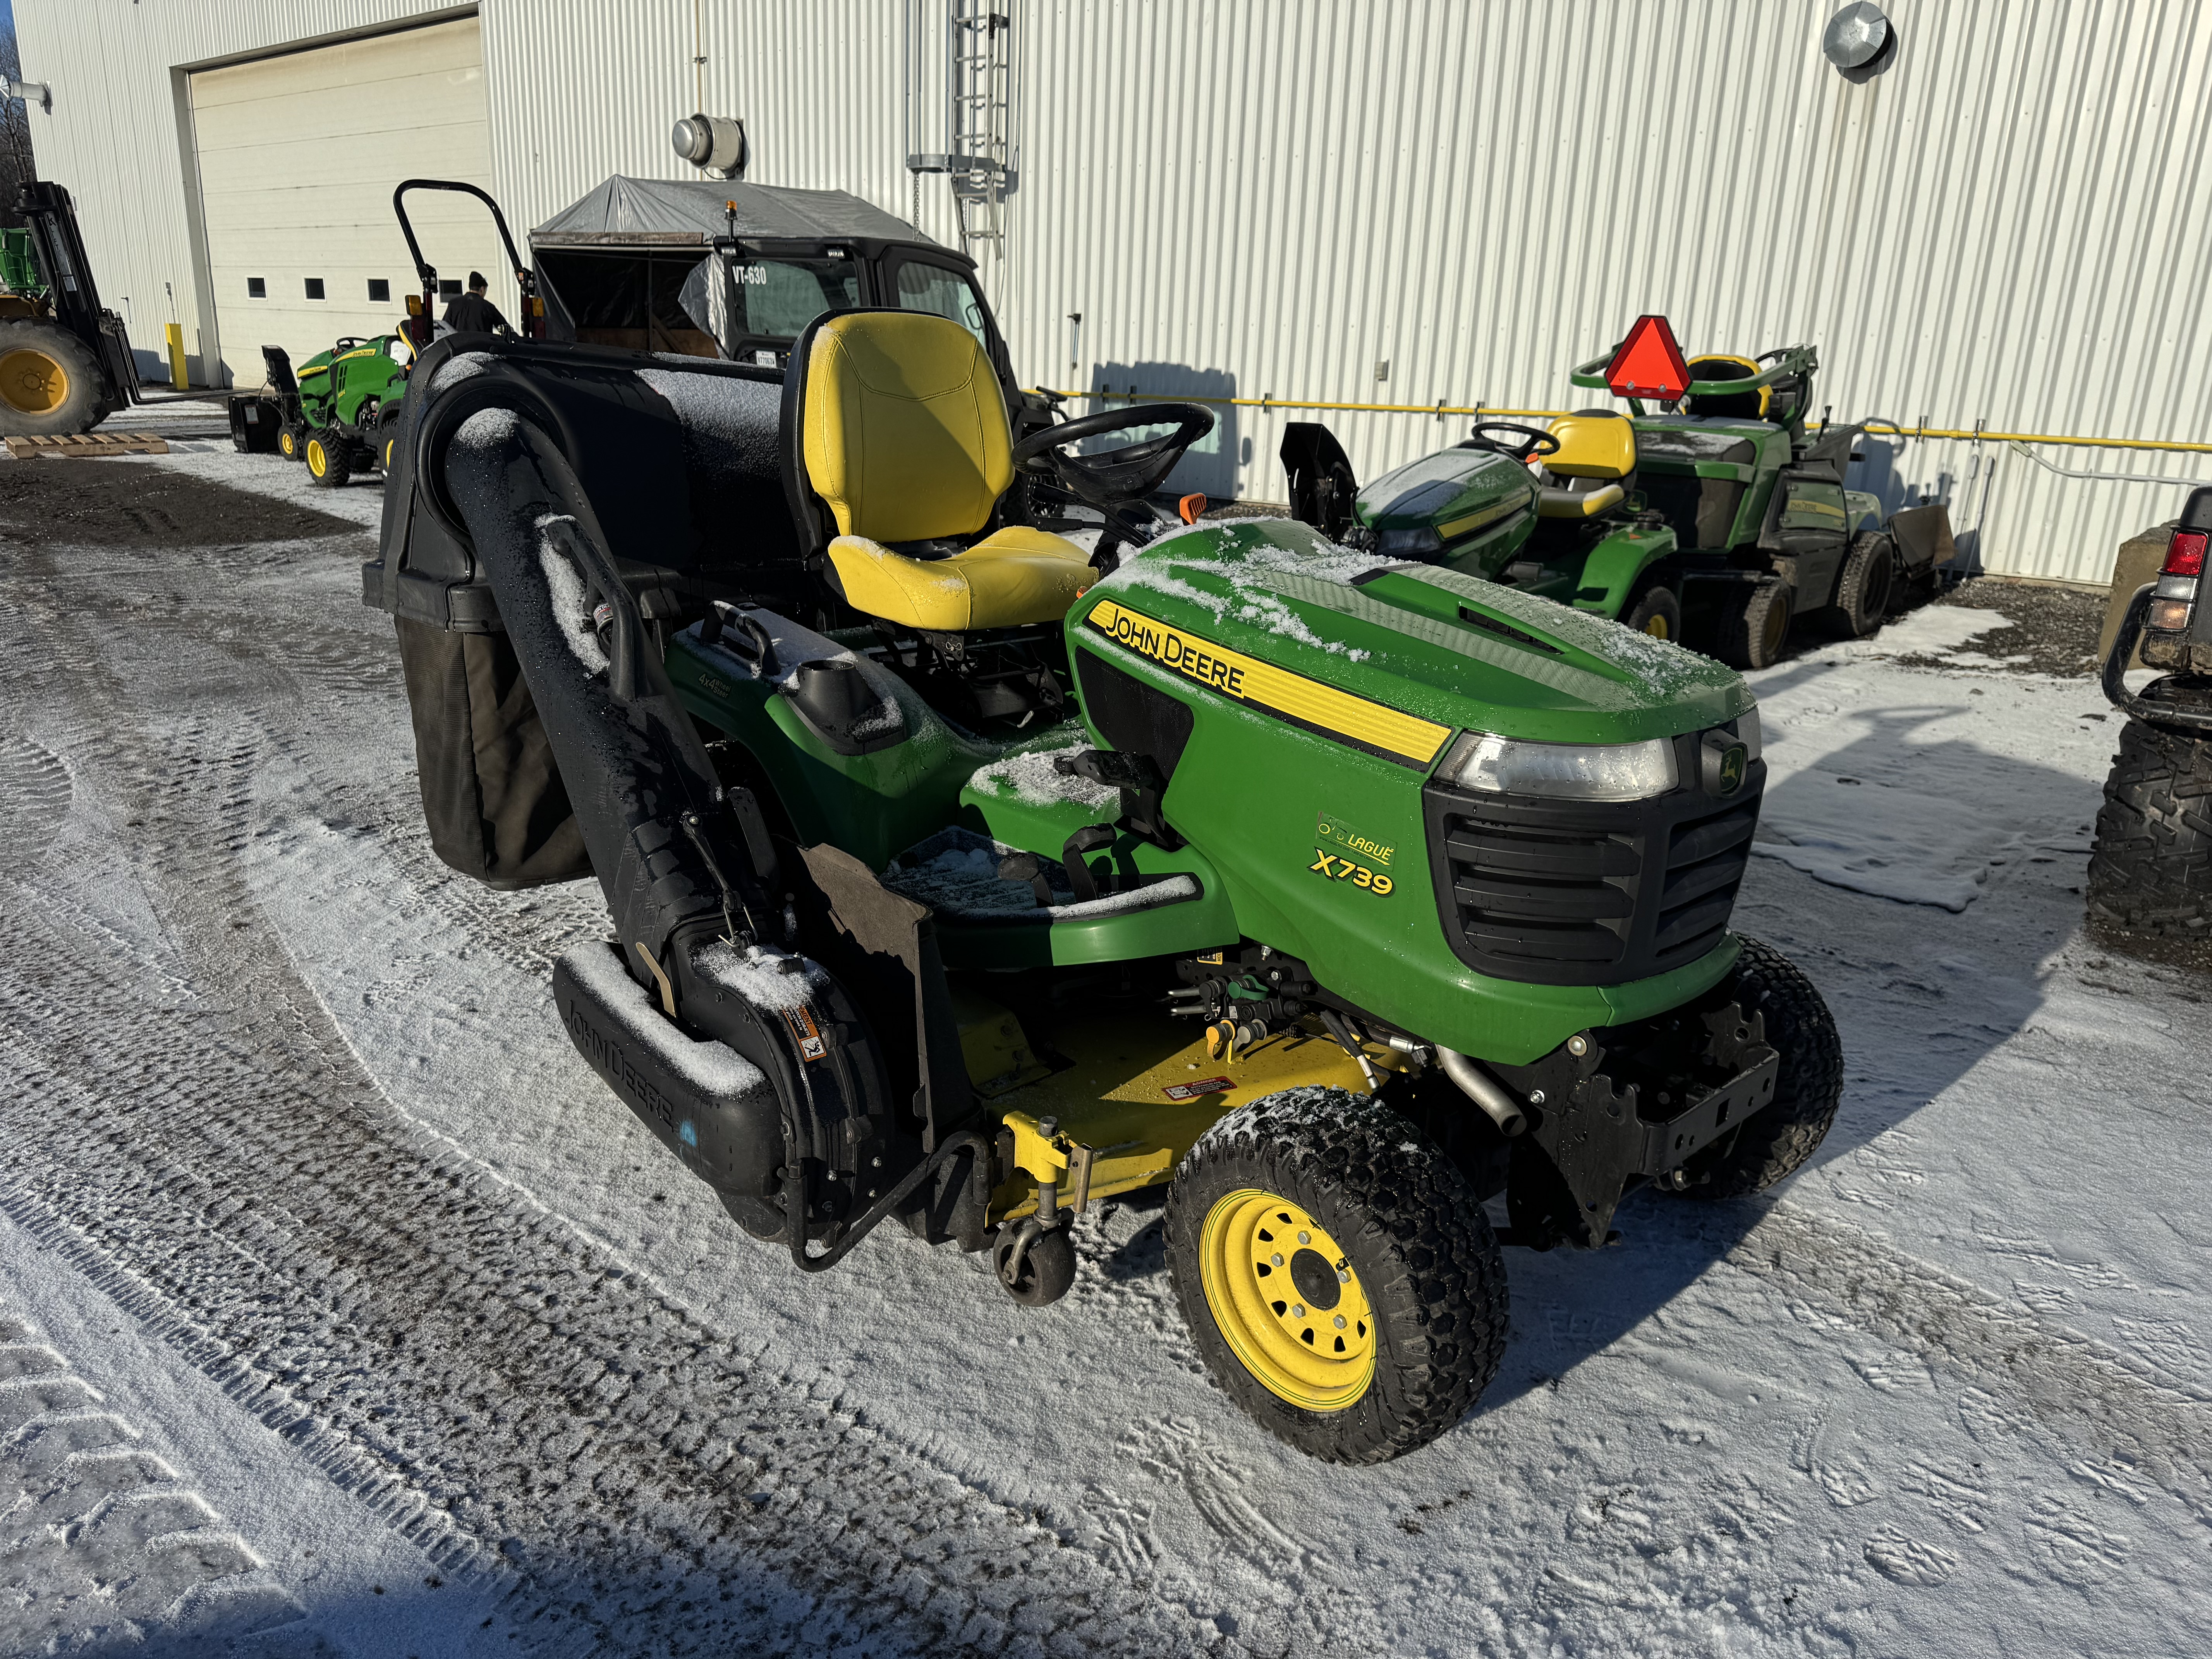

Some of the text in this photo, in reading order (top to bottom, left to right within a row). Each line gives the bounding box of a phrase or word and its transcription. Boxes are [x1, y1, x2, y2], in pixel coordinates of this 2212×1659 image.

[732, 265, 767, 285] VT-630
[1106, 608, 1245, 694] JOHN DEERE
[698, 673, 732, 692] 4x4 Wheel
[713, 686, 728, 698] Steer
[1309, 848, 1394, 895] X739
[564, 999, 675, 1133] JOHN DEERE
